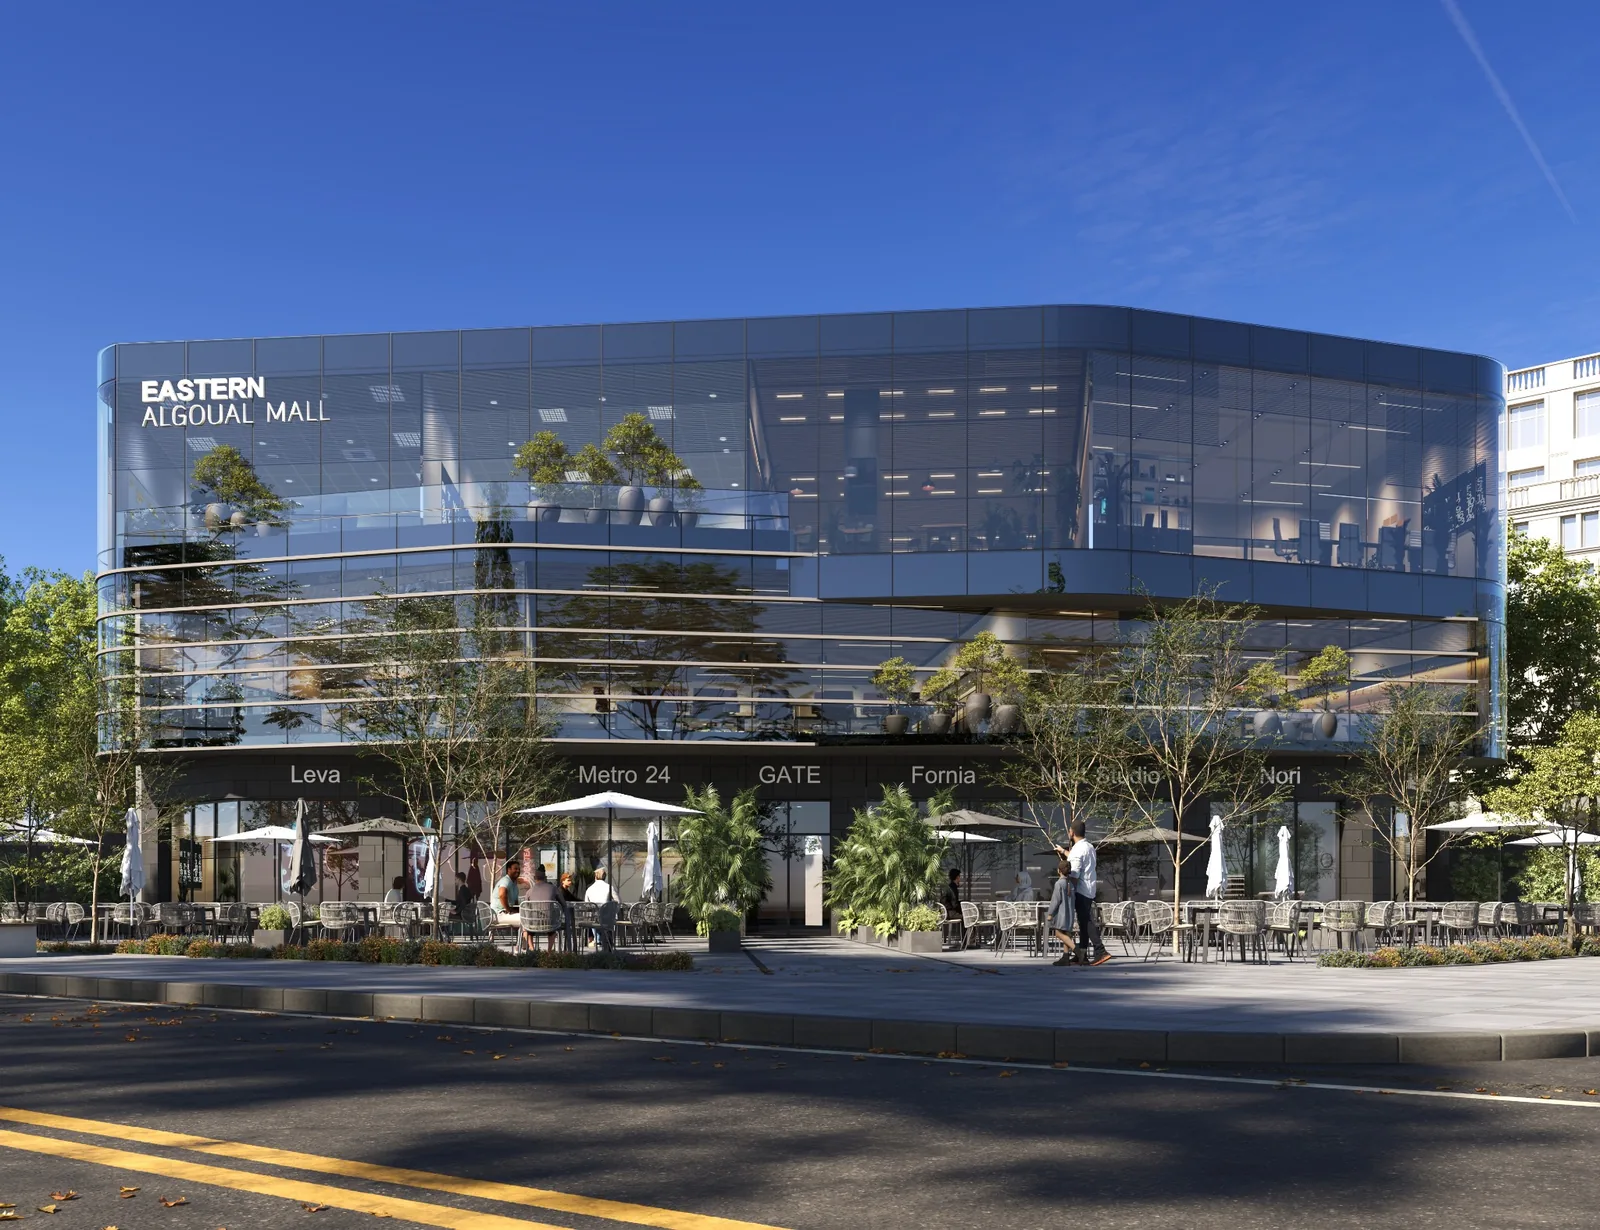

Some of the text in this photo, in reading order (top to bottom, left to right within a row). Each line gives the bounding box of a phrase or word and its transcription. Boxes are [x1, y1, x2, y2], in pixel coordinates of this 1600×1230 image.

[142, 376, 265, 402] EASTERN
[142, 400, 330, 426] ALGOUAL MALL
[291, 765, 341, 783] Leva
[579, 765, 671, 783] Metro 24
[759, 765, 821, 783] GATE
[911, 765, 977, 784] Fornia
[1095, 765, 1161, 784] Studio
[1260, 765, 1301, 784] Nori
